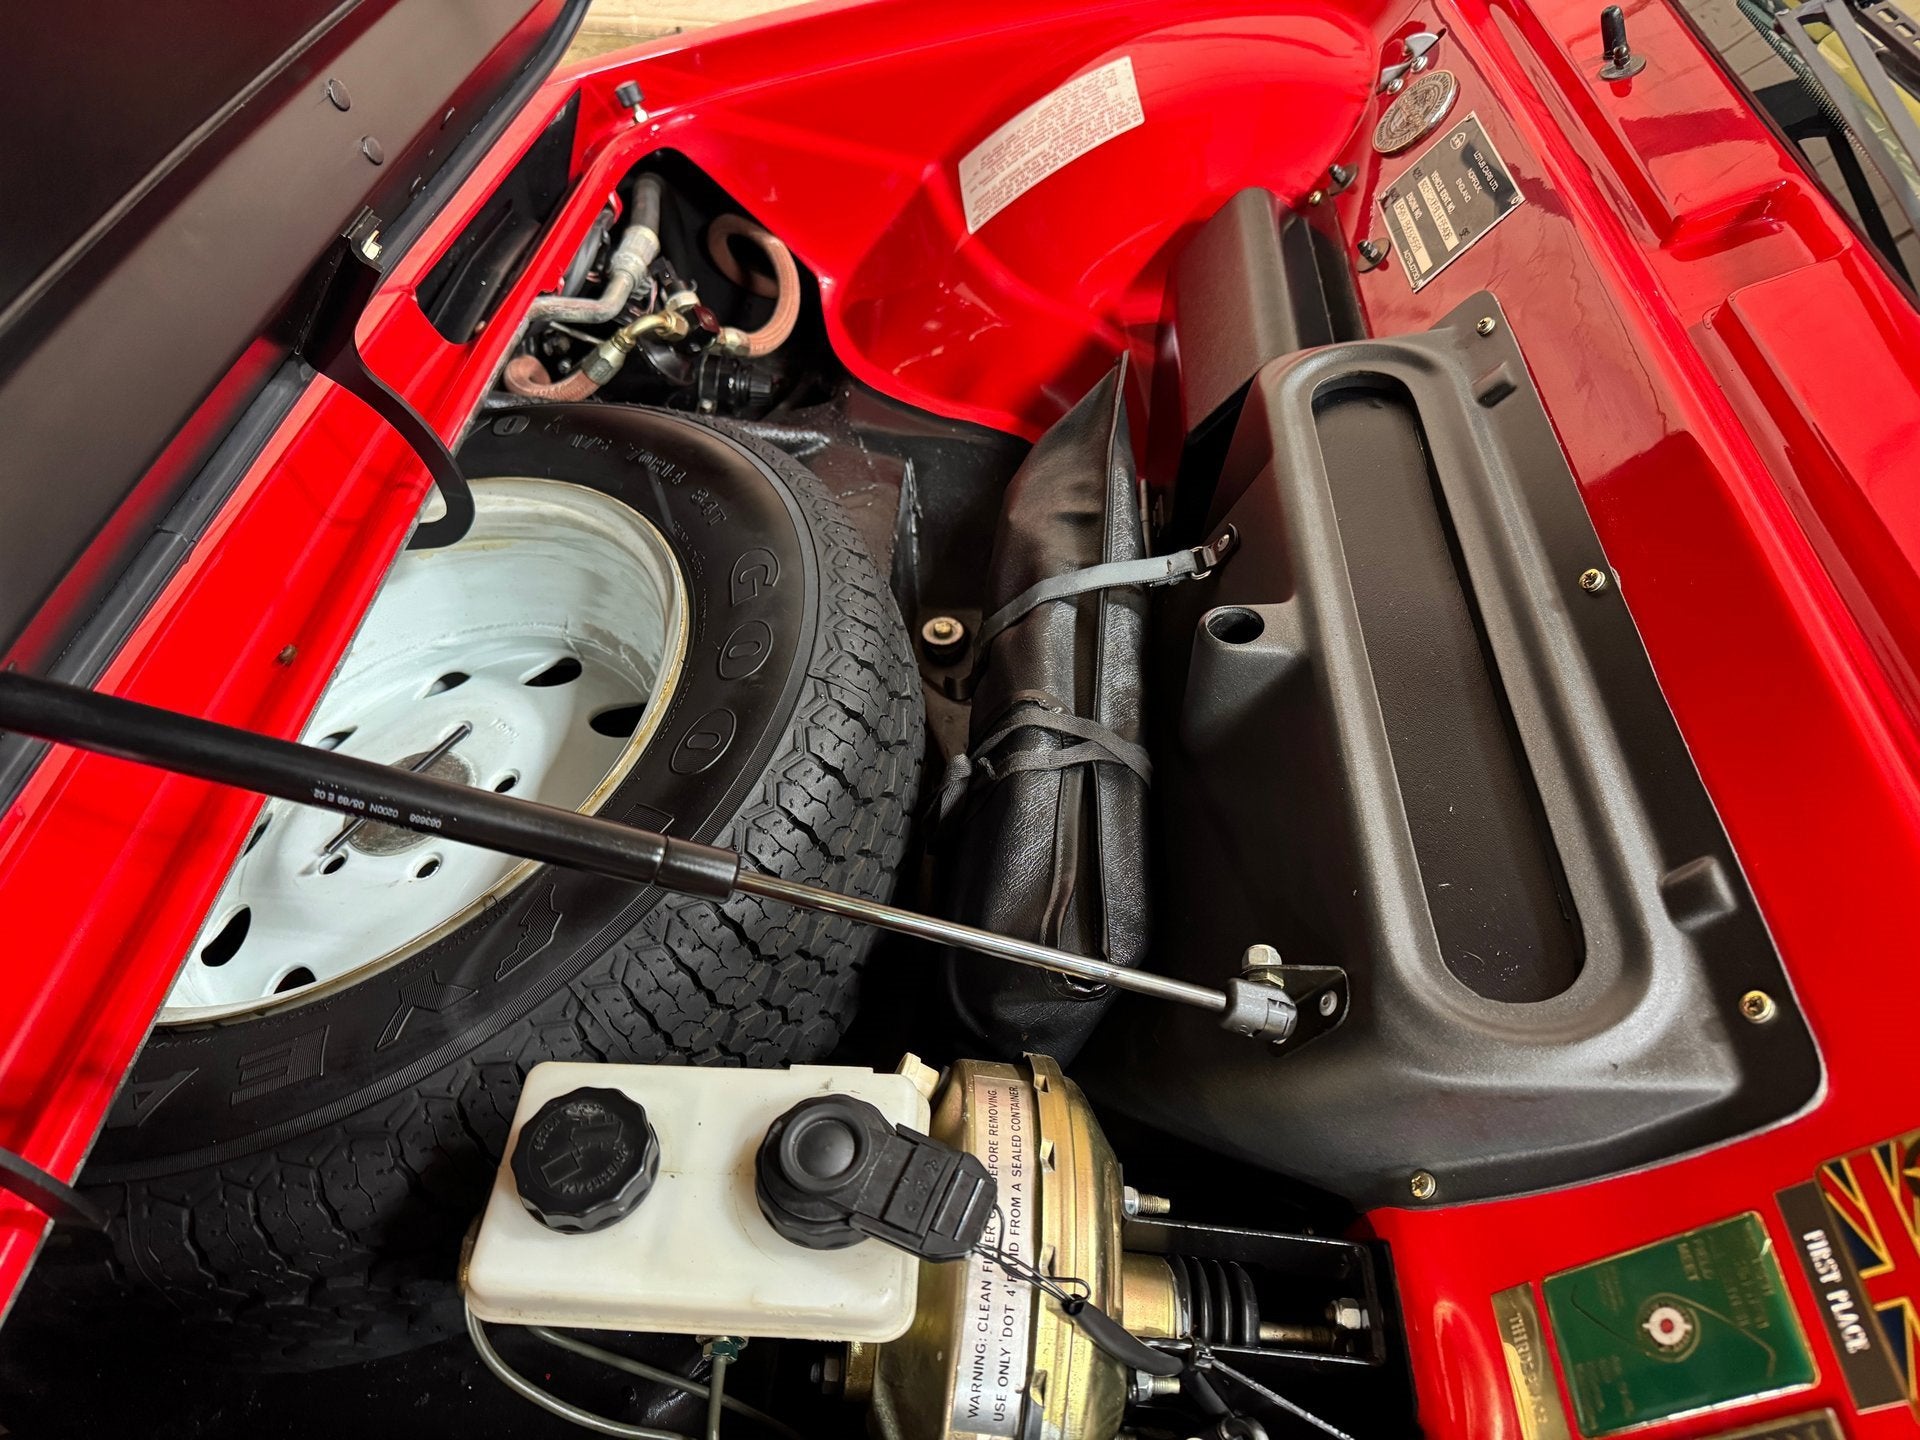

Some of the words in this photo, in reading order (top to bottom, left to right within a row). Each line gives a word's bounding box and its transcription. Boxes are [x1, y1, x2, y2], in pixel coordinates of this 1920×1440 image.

[1429, 169, 1444, 192] VEHICLE
[1472, 149, 1486, 169] LOTUS
[1481, 164, 1494, 182] CARS
[1488, 177, 1499, 192] LTD.
[1405, 191, 1419, 212] ENGINE
[1011, 1134, 1022, 1178] SEALED
[1011, 1183, 1022, 1193] A
[1009, 1196, 1022, 1237] FROM
[1007, 1242, 1020, 1283] FUID
[977, 1280, 992, 1333] CLEAN
[1802, 1227, 1844, 1286] FIRST
[1825, 1288, 1871, 1356] PLACE
[967, 1337, 988, 1419] WARNING:
[997, 1347, 1011, 1388] ONLY
[993, 1393, 1008, 1422] USE
